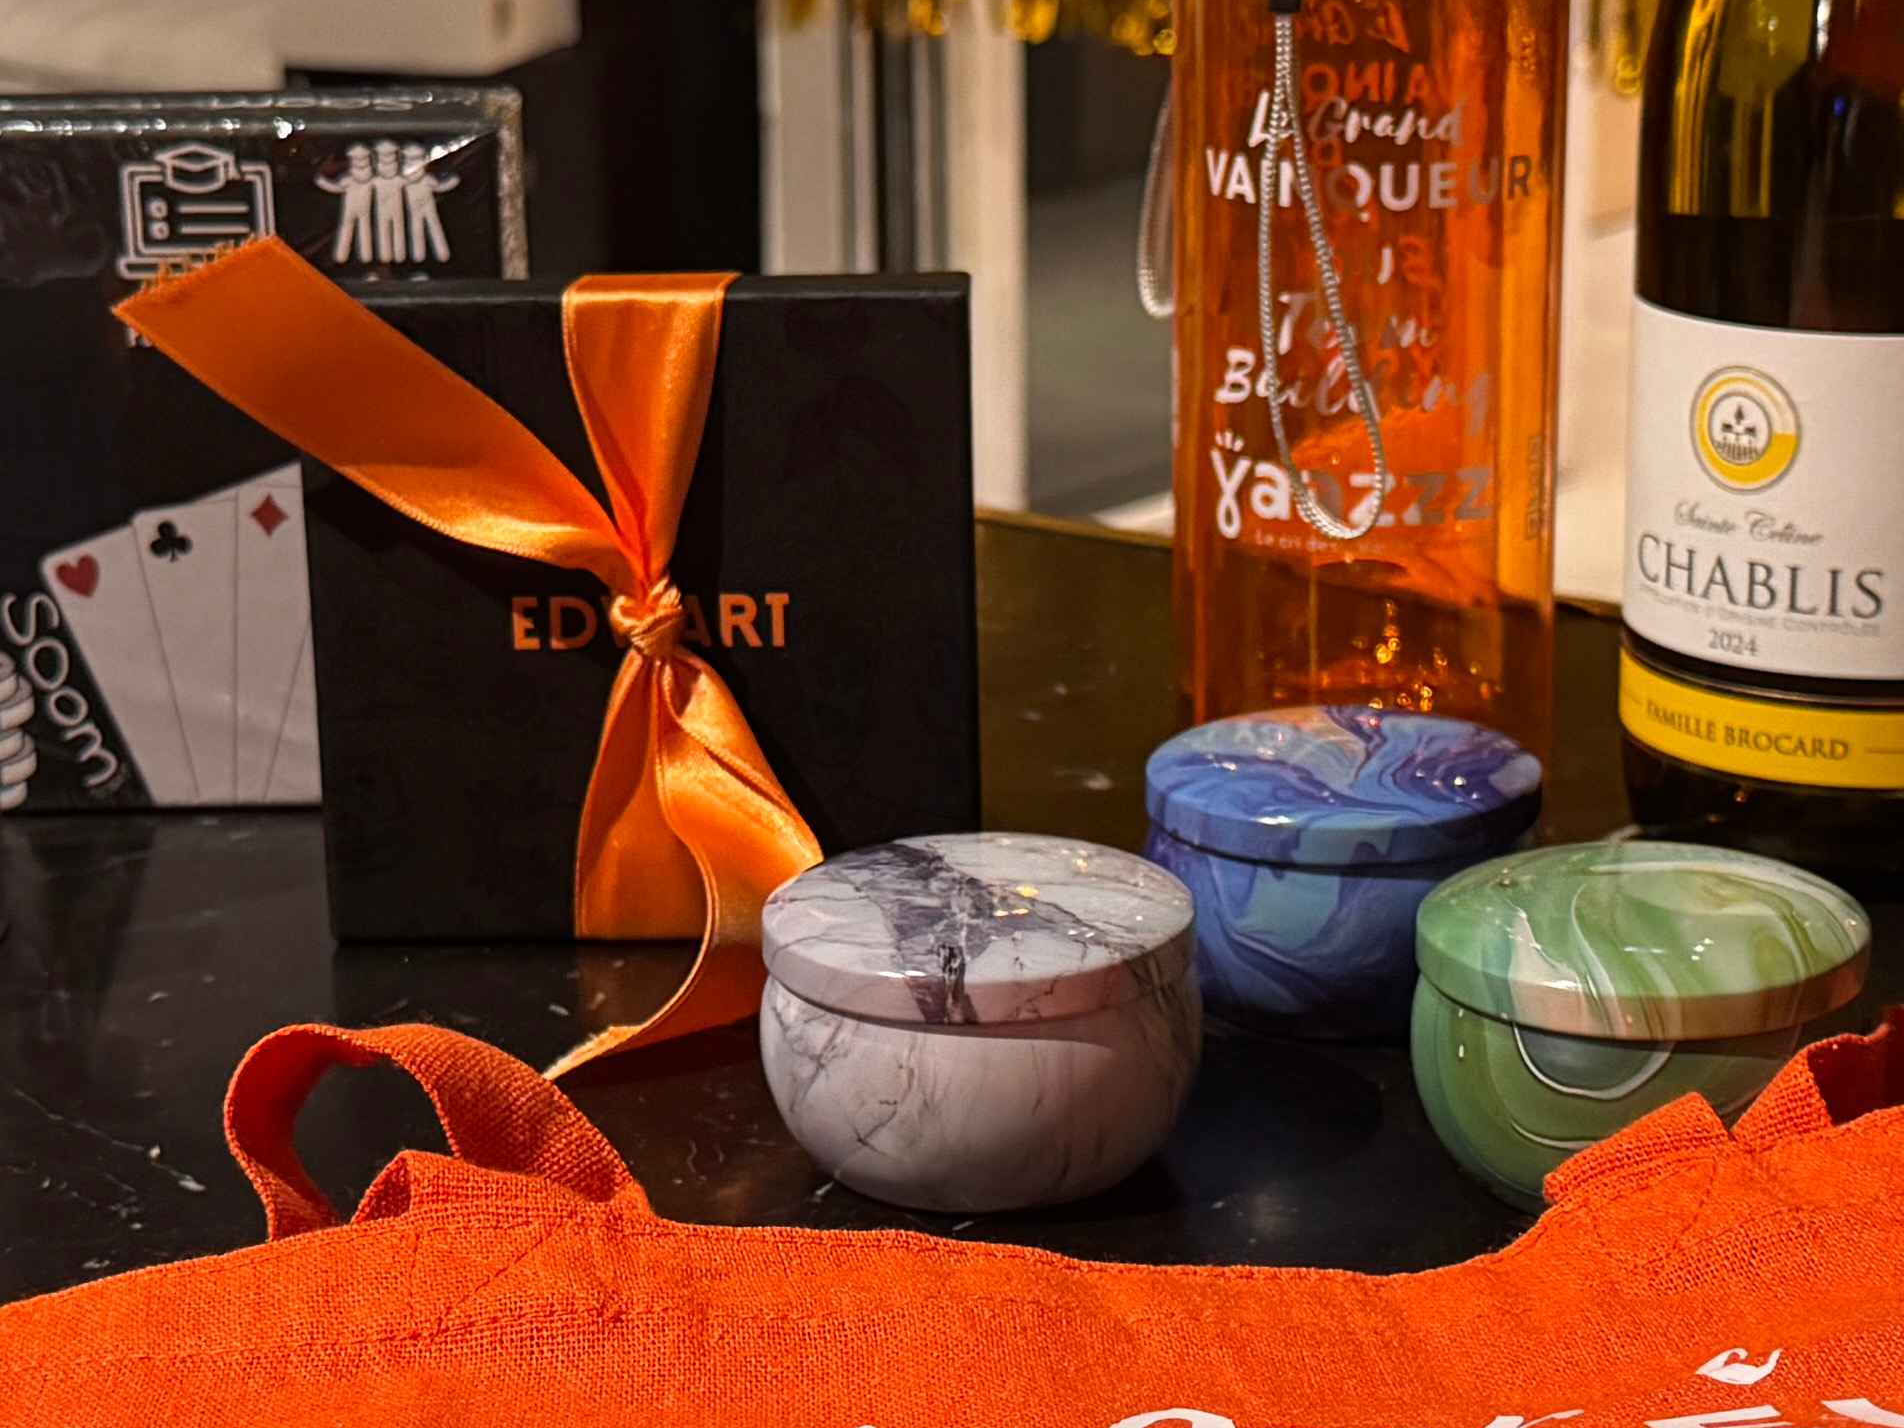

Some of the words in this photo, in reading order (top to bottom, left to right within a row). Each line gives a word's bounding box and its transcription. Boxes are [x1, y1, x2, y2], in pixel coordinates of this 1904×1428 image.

[1309, 96, 1465, 148] Grand
[1637, 532, 1885, 620] CHABLIS
[1708, 628, 1760, 656] 2024
[1646, 699, 1717, 742] FAMILLE
[1724, 724, 1850, 761] BROCARD
